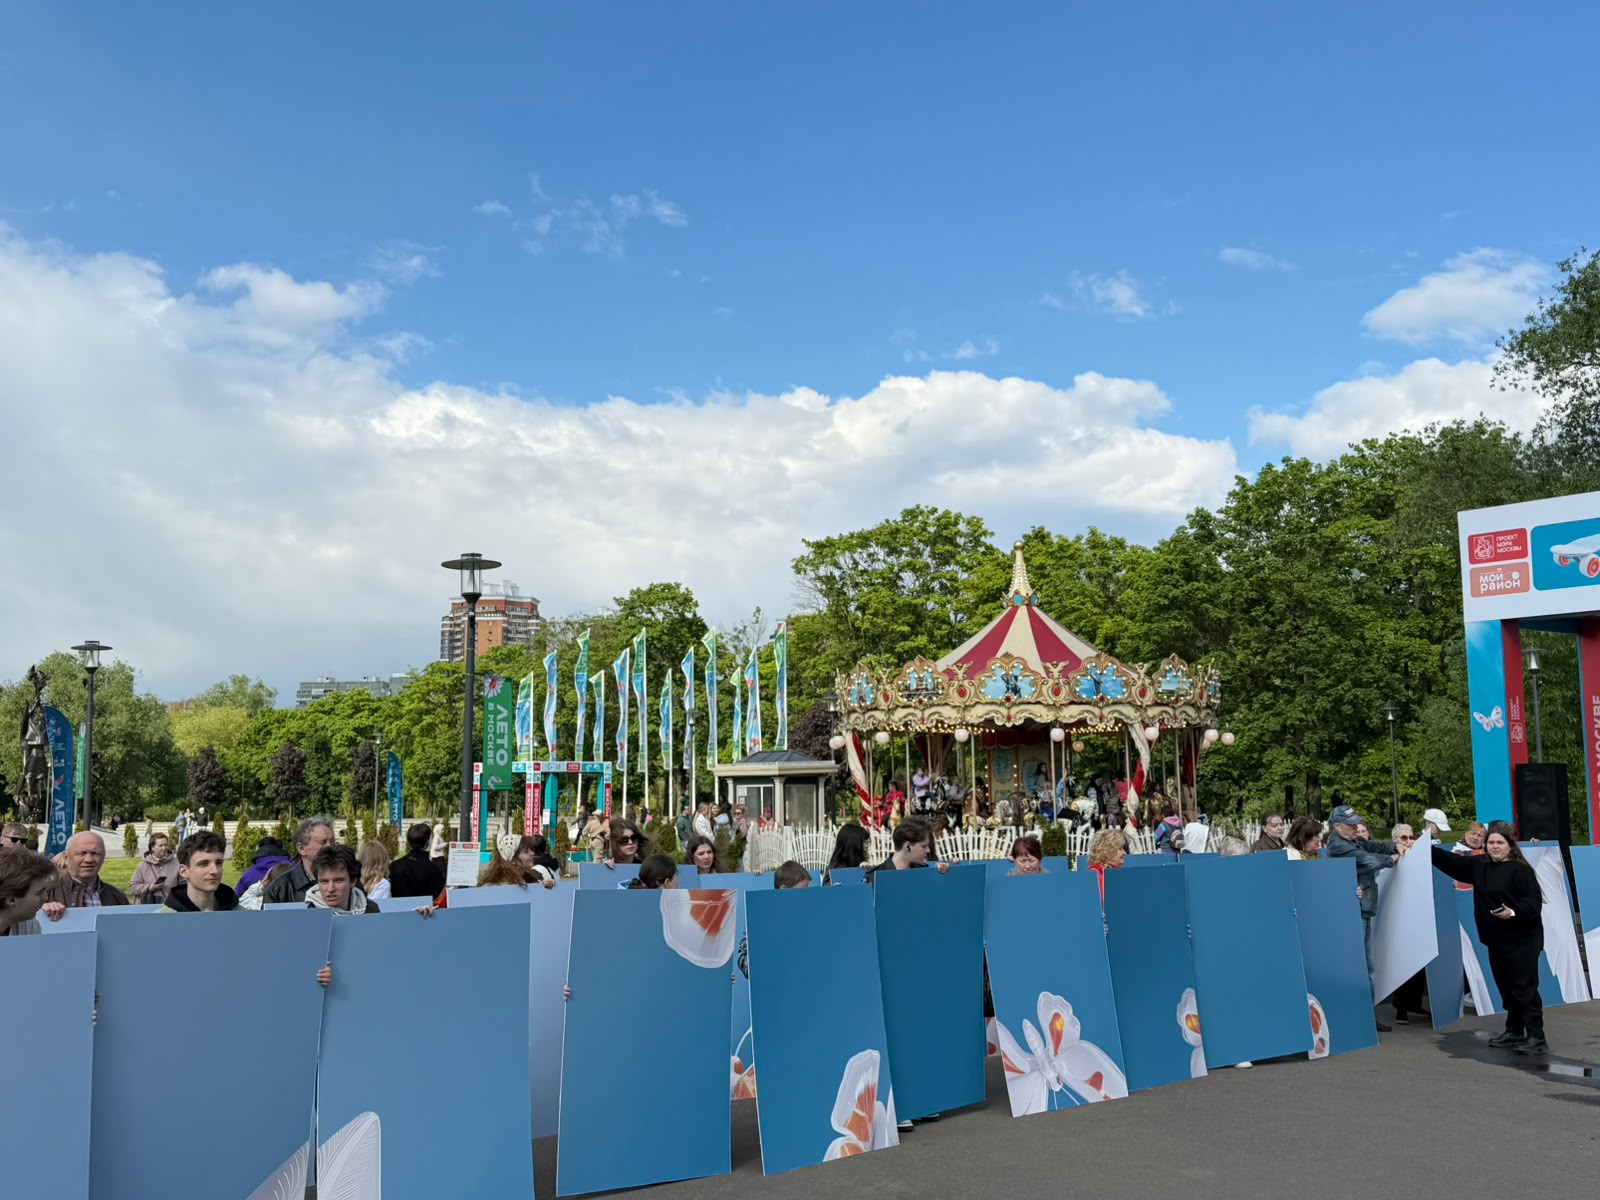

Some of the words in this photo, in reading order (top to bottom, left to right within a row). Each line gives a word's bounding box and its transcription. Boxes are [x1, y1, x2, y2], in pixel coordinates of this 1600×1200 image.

[487, 702, 495, 710] В
[487, 714, 495, 766] МОСКВЕ
[495, 704, 509, 767] ЛЕТО
[55, 799, 67, 845] ЛЕТО
